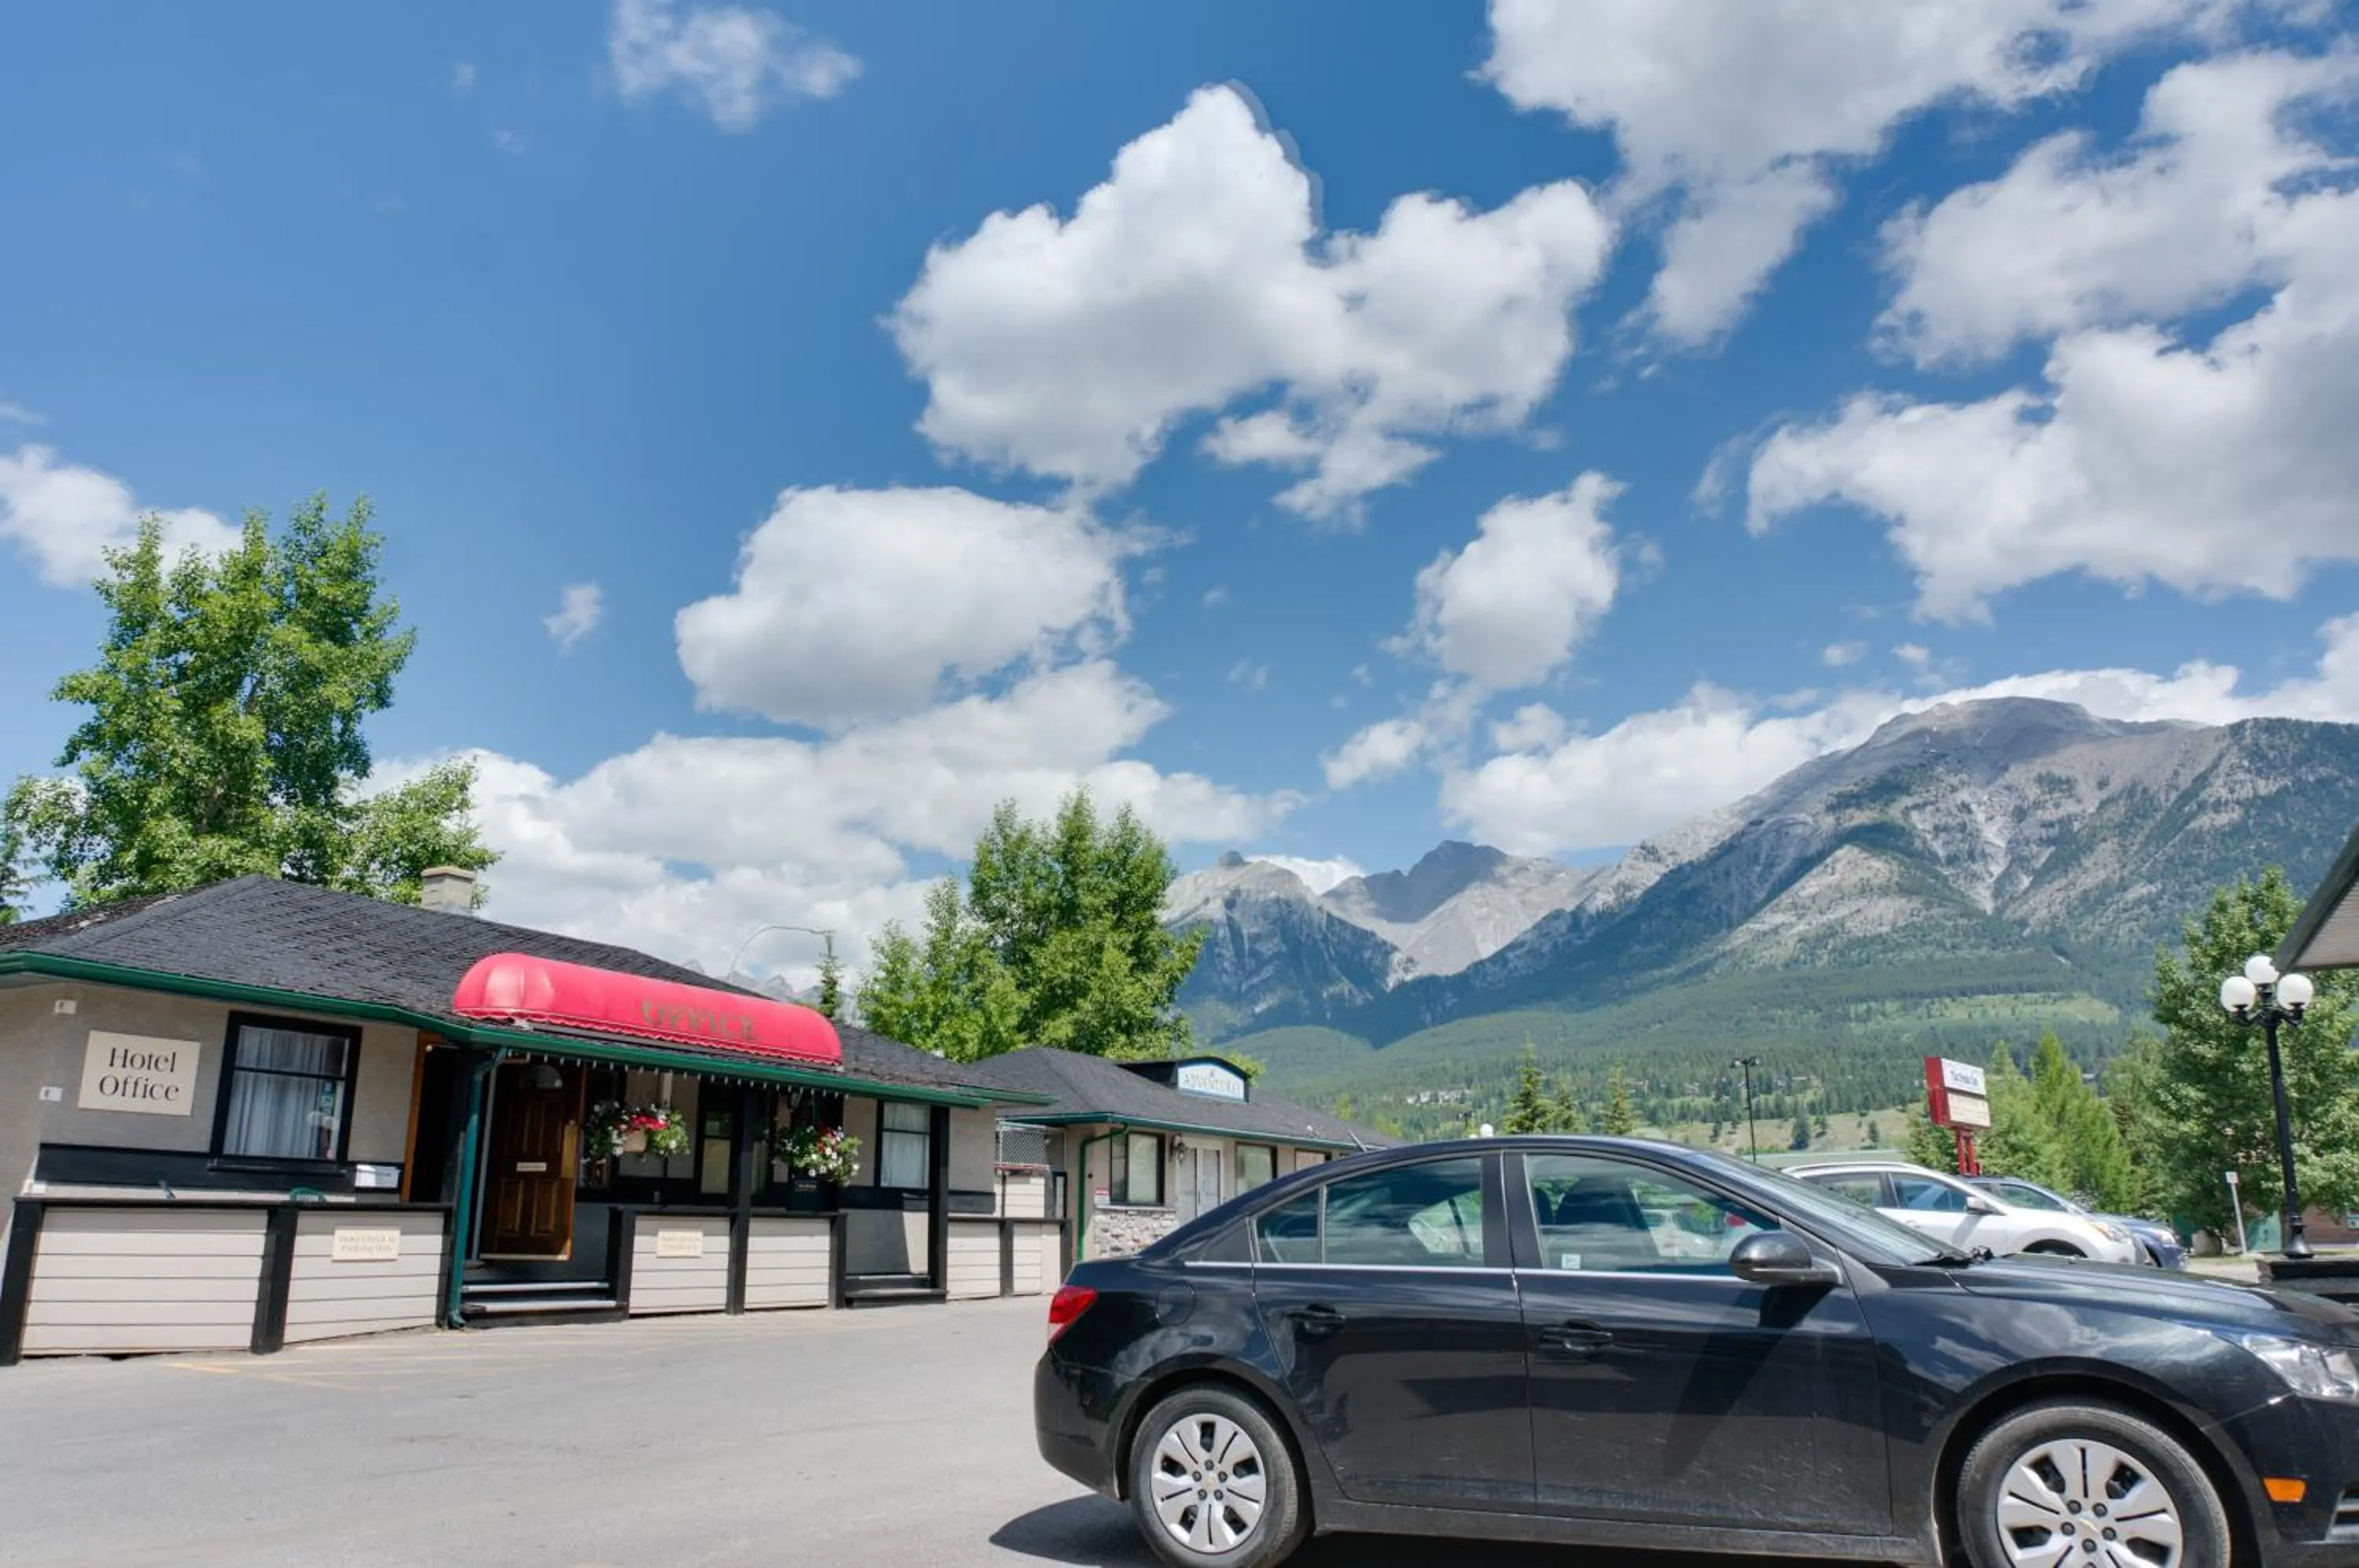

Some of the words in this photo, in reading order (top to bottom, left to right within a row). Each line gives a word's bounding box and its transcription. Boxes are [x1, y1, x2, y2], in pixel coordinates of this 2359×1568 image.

[642, 996, 759, 1040] OFFICE
[109, 1047, 177, 1073] Hotel
[99, 1074, 179, 1102] Office
